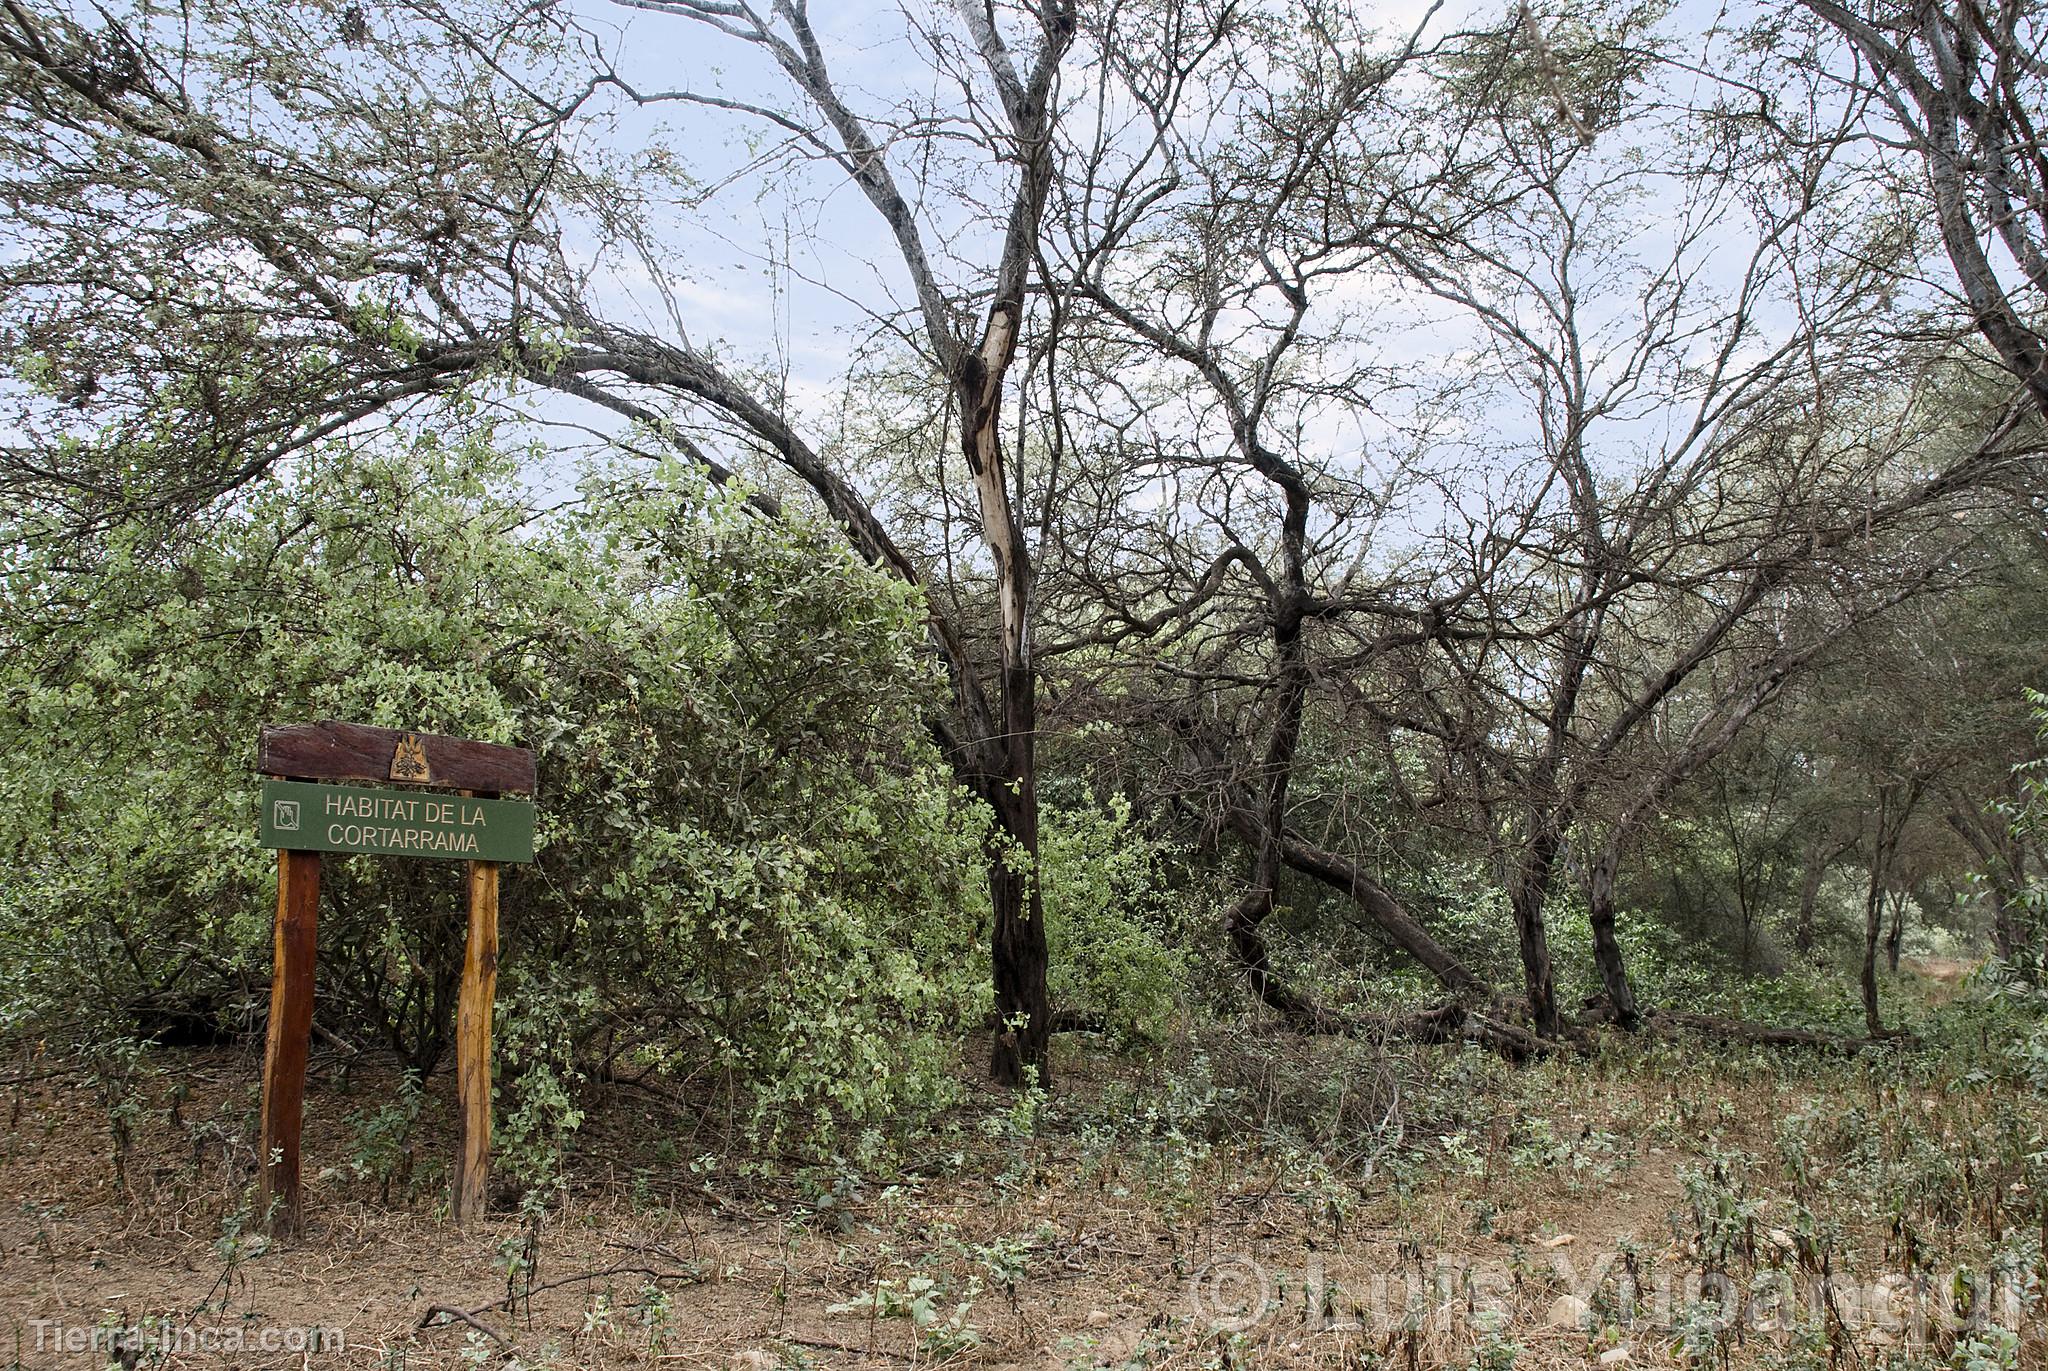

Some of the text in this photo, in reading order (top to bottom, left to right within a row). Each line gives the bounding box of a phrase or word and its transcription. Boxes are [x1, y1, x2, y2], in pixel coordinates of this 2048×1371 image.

[325, 794, 486, 826] HABITAT DE LA
[327, 824, 480, 853] CORTARRAMA
